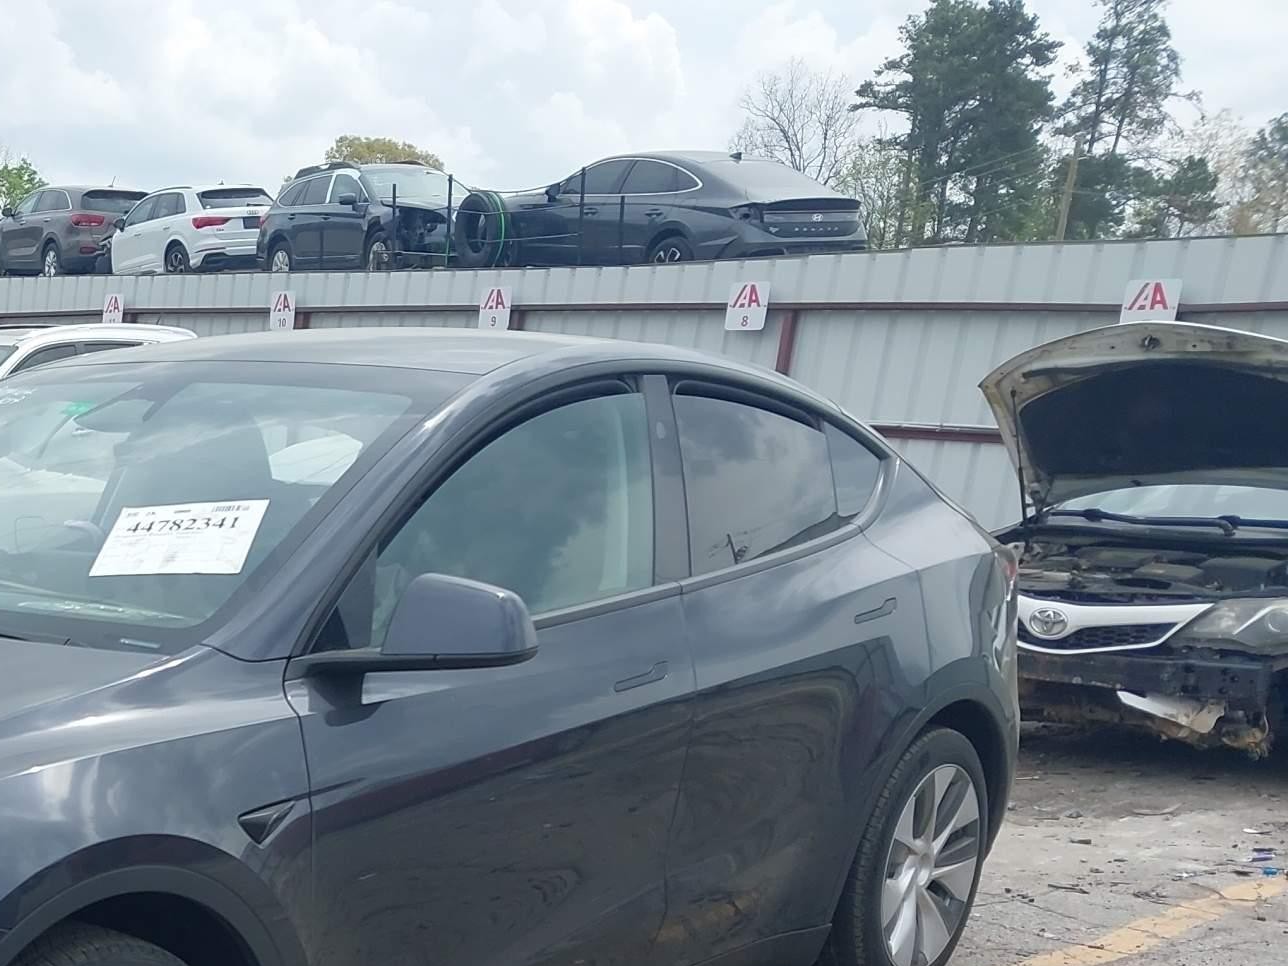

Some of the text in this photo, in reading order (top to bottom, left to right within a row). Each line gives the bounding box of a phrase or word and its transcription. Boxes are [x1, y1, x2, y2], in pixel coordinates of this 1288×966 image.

[277, 318, 287, 328] 10
[490, 315, 497, 327] 9
[740, 315, 749, 327] 8
[126, 515, 241, 534] 44782341
